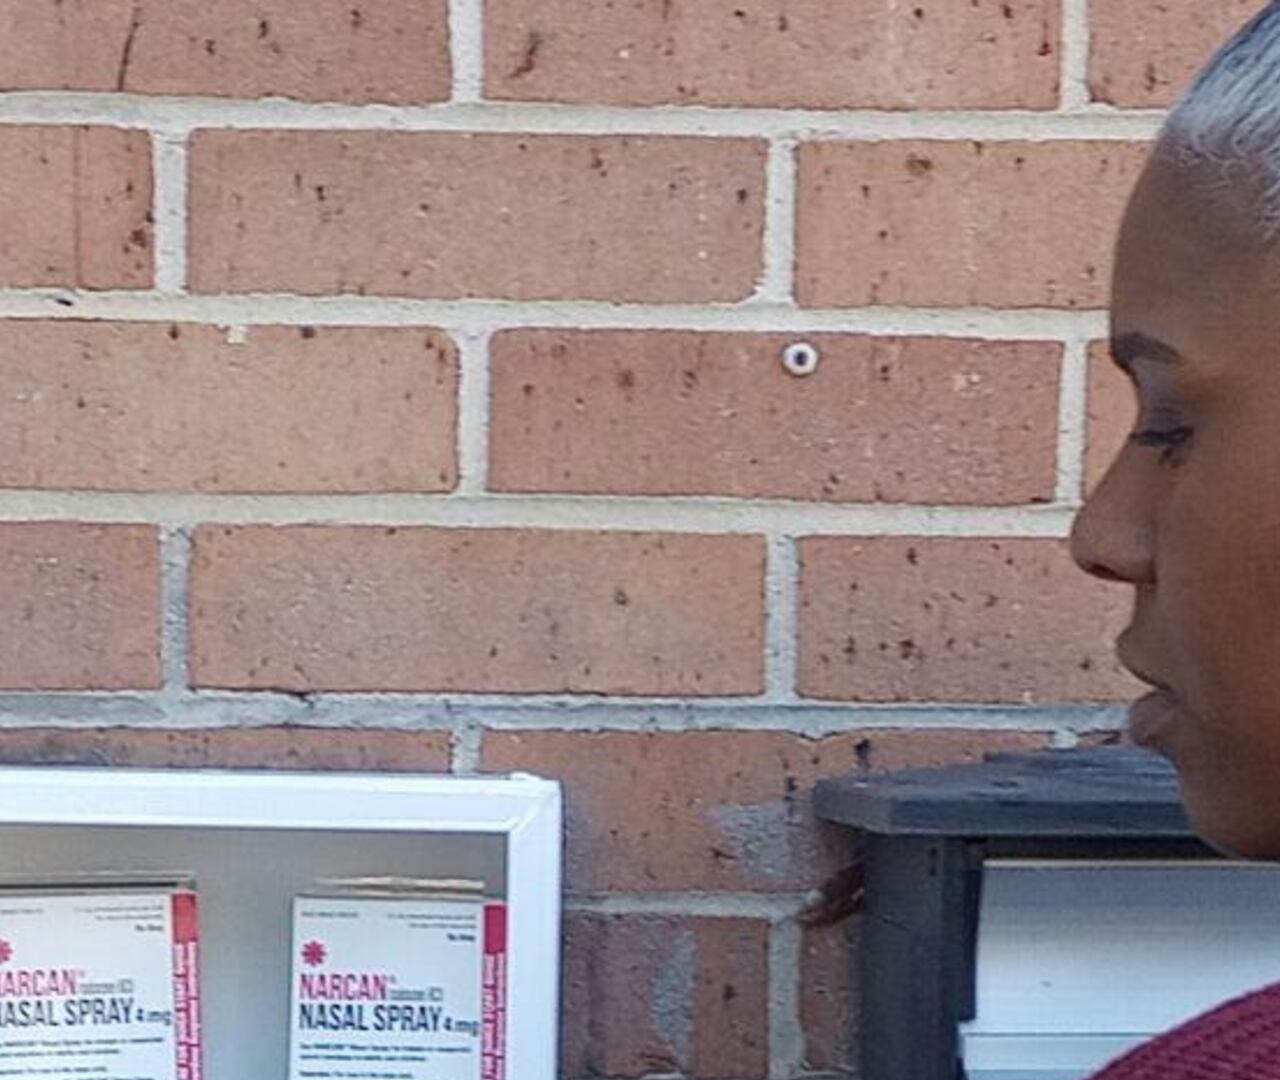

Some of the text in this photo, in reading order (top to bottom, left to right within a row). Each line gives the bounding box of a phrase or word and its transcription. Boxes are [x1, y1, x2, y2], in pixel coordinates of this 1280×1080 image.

[300, 973, 387, 1001] NARCAN
[64, 998, 134, 1026] SPRAY
[299, 1003, 369, 1031] NASAL
[373, 1004, 442, 1032] SPRAY
